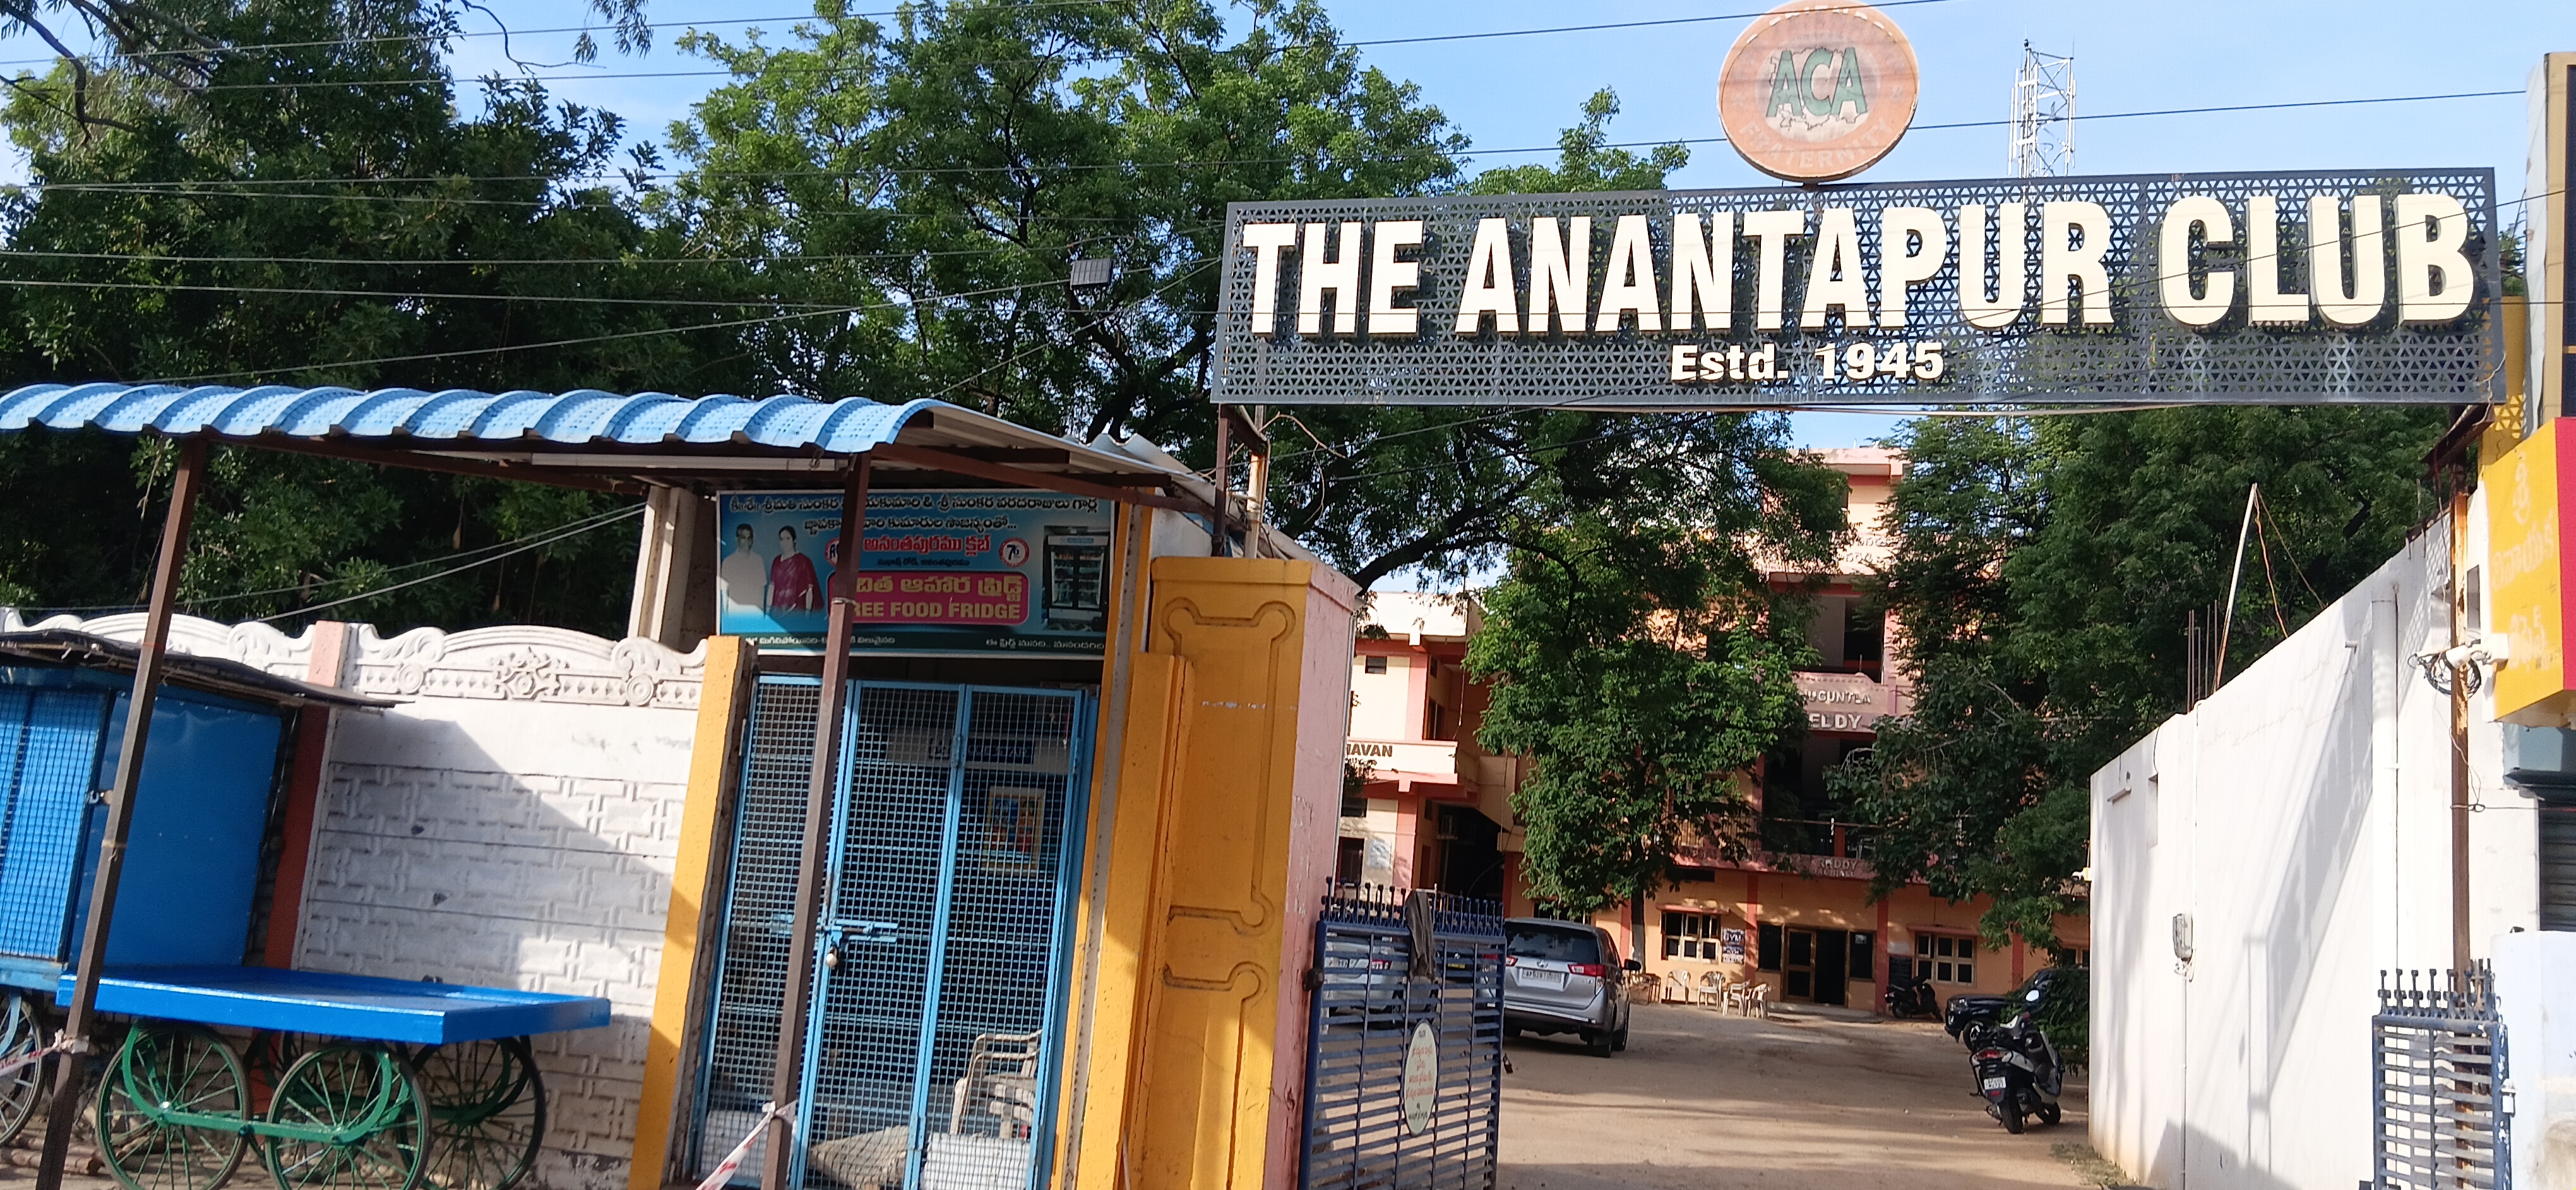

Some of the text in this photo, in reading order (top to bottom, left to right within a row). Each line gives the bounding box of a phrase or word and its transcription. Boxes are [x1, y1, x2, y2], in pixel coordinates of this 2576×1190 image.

[1766, 47, 1868, 117] ACA
[1243, 193, 2476, 336] THE ANANTAPUR CLUB
[1671, 340, 1945, 383] Estd. 1945
[923, 496, 933, 508] &
[937, 494, 950, 512] శ్రీ
[863, 534, 991, 557] అనంతపురము క్లబ్
[900, 575, 970, 592] ఆహార
[854, 601, 1020, 620] REE FOOD FRIDGE
[1808, 712, 1863, 730] EDDY
